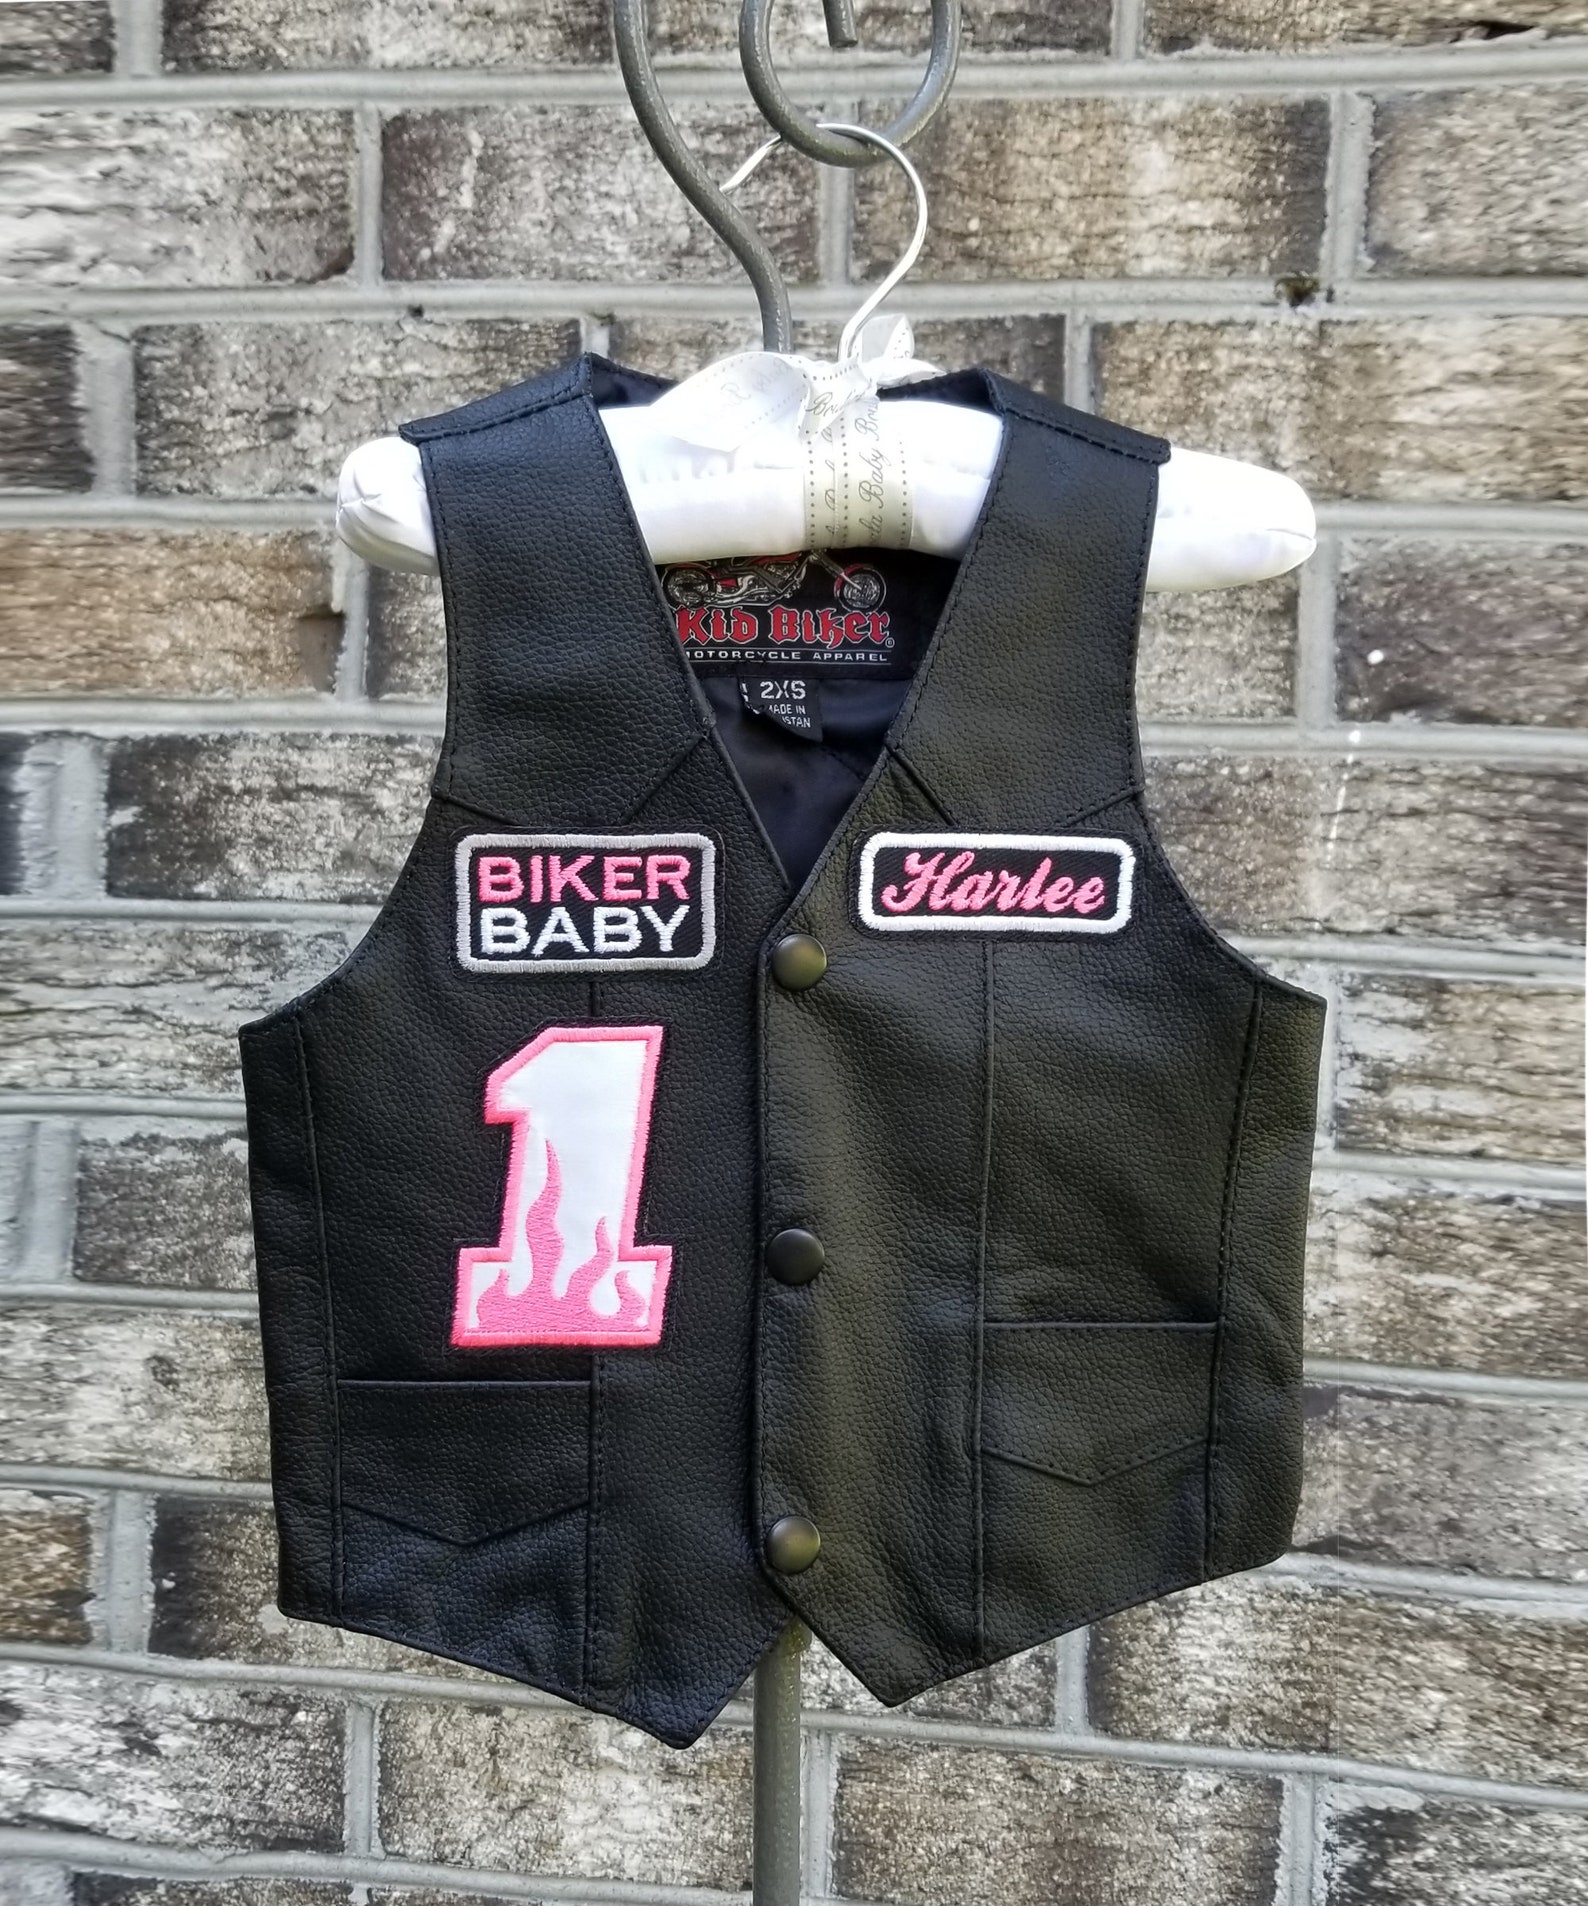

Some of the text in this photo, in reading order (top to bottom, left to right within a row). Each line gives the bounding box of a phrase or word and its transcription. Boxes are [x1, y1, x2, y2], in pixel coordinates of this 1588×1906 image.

[858, 446, 892, 509] Baby
[675, 604, 892, 649] Kid Biker
[812, 651, 889, 662] APPAREL
[759, 680, 807, 700] 2XS
[795, 704, 806, 715] IN
[477, 854, 691, 903] BIKER
[881, 851, 1105, 914] Harlee
[480, 904, 690, 957] BABY
[451, 1025, 673, 1347] 1
